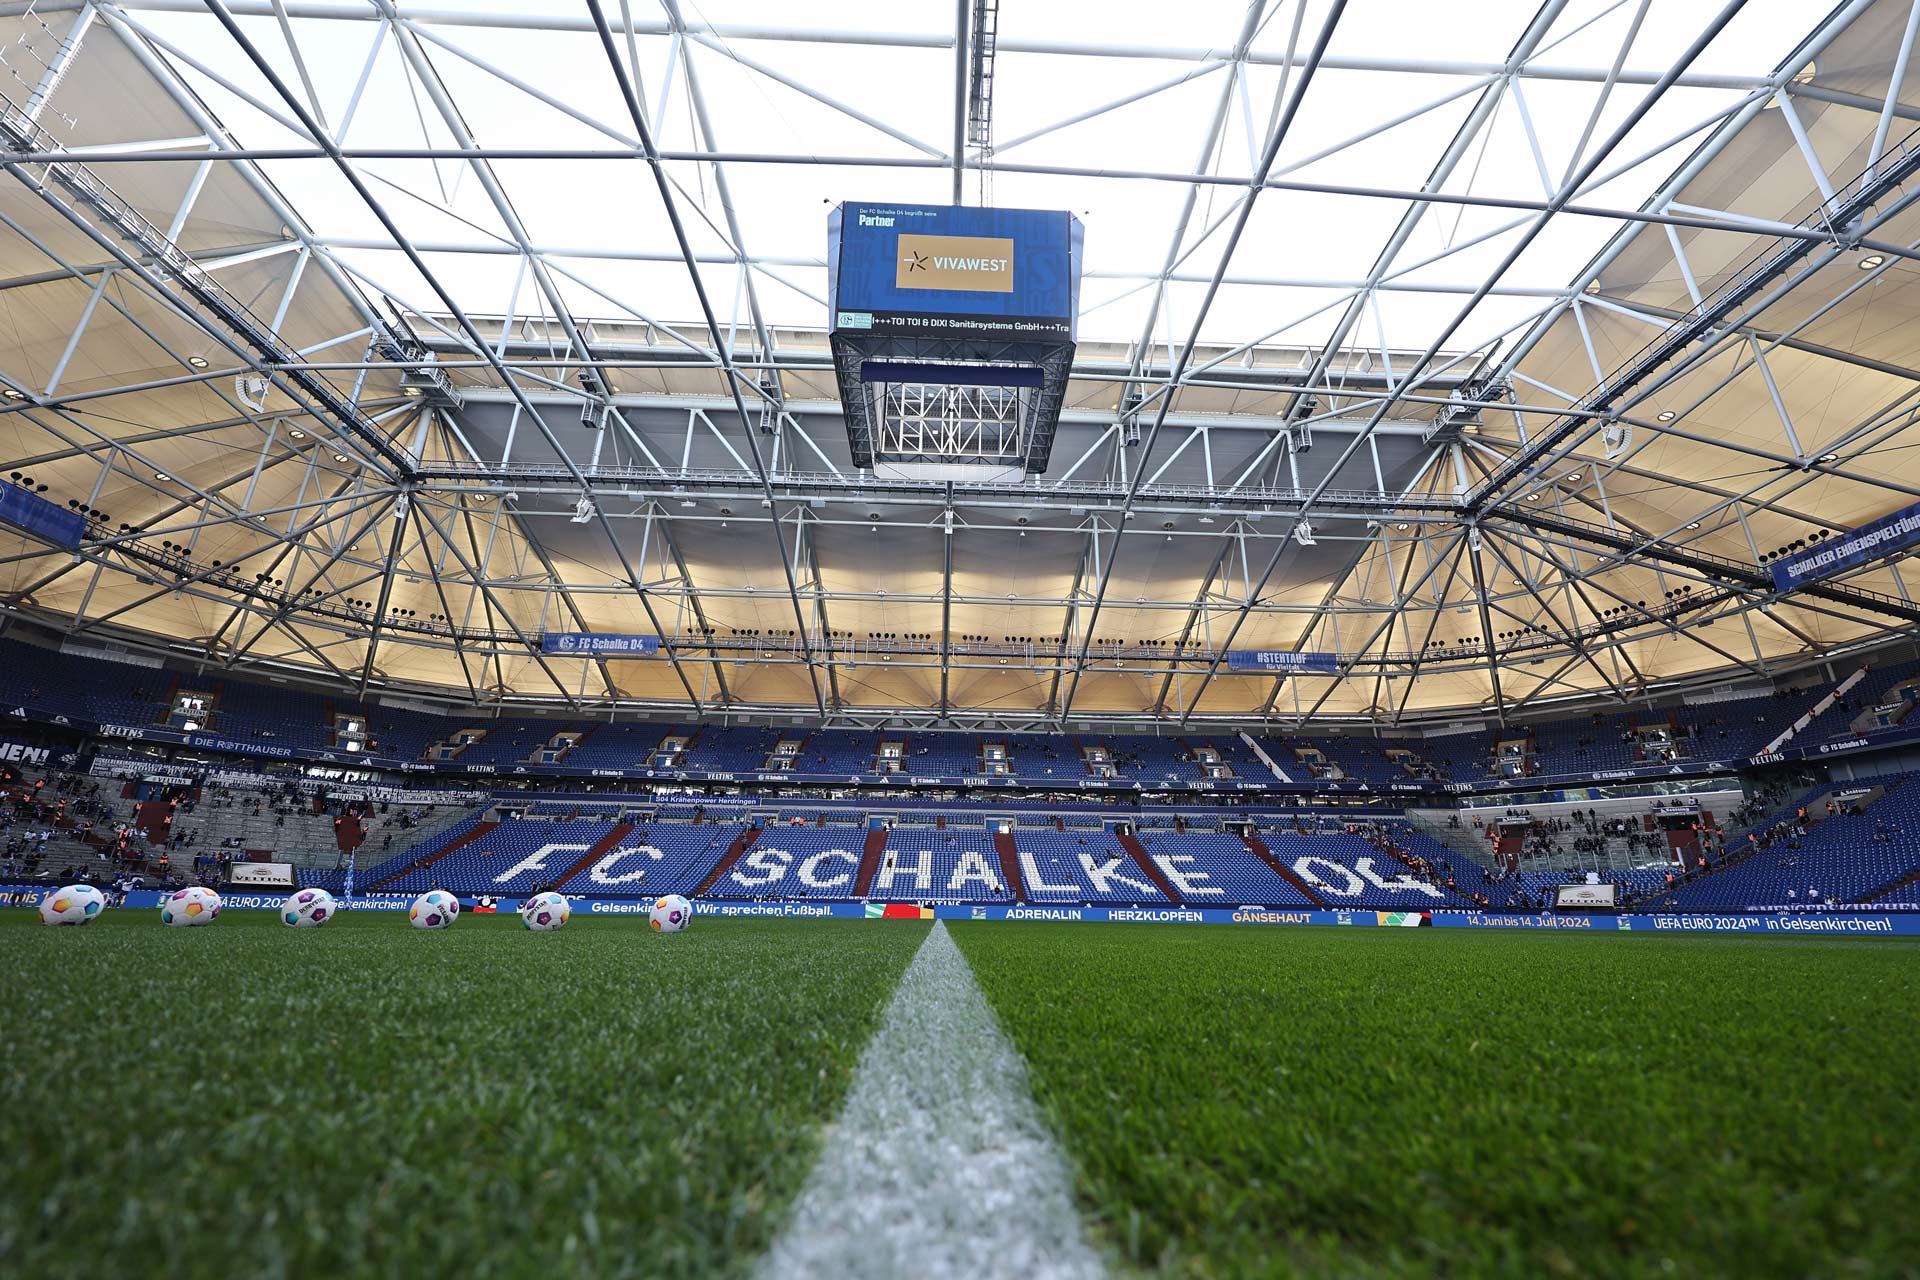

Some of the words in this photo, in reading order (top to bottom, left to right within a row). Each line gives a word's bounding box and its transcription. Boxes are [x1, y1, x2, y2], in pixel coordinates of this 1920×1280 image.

[859, 214, 896, 227] Partner
[933, 256, 1008, 272] VIVAWEST
[907, 318, 921, 326] TOI
[922, 318, 929, 326] &
[930, 319, 947, 327] DIXI
[949, 319, 1013, 331] Sanitärsysteme
[1787, 550, 1836, 578] SCHALKER
[579, 638, 591, 649] FC
[592, 638, 628, 649] Schalke
[630, 639, 643, 650] 04
[1257, 652, 1307, 664] #STEHTAUF
[195, 737, 214, 747] DIE
[1749, 752, 1785, 765] VELTINS
[467, 765, 495, 773] VELTINS
[707, 772, 734, 780] VELTINS
[493, 843, 664, 885] FC
[731, 848, 1225, 895] SCHALKE
[1292, 856, 1445, 898] 04
[229, 897, 261, 908] EURO
[696, 904, 720, 914] Wir
[721, 904, 782, 916] sprechen
[784, 905, 833, 916] Fußball.
[1005, 909, 1082, 920] ADRENALIN
[1232, 909, 1312, 923] GÄNSEHAUT
[1108, 911, 1203, 922] HERZKLOPFEN
[1466, 916, 1482, 926] 14.
[1483, 916, 1503, 926] Juni
[1504, 916, 1519, 926] bis
[1519, 916, 1534, 927] 14.
[1536, 917, 1557, 928] Juli
[1558, 917, 1591, 928] 2024
[1653, 918, 1682, 929] UEFA
[1682, 918, 1713, 929] EURO
[1765, 917, 1779, 930] in
[1780, 917, 1893, 931] Gelsenkirchen!
